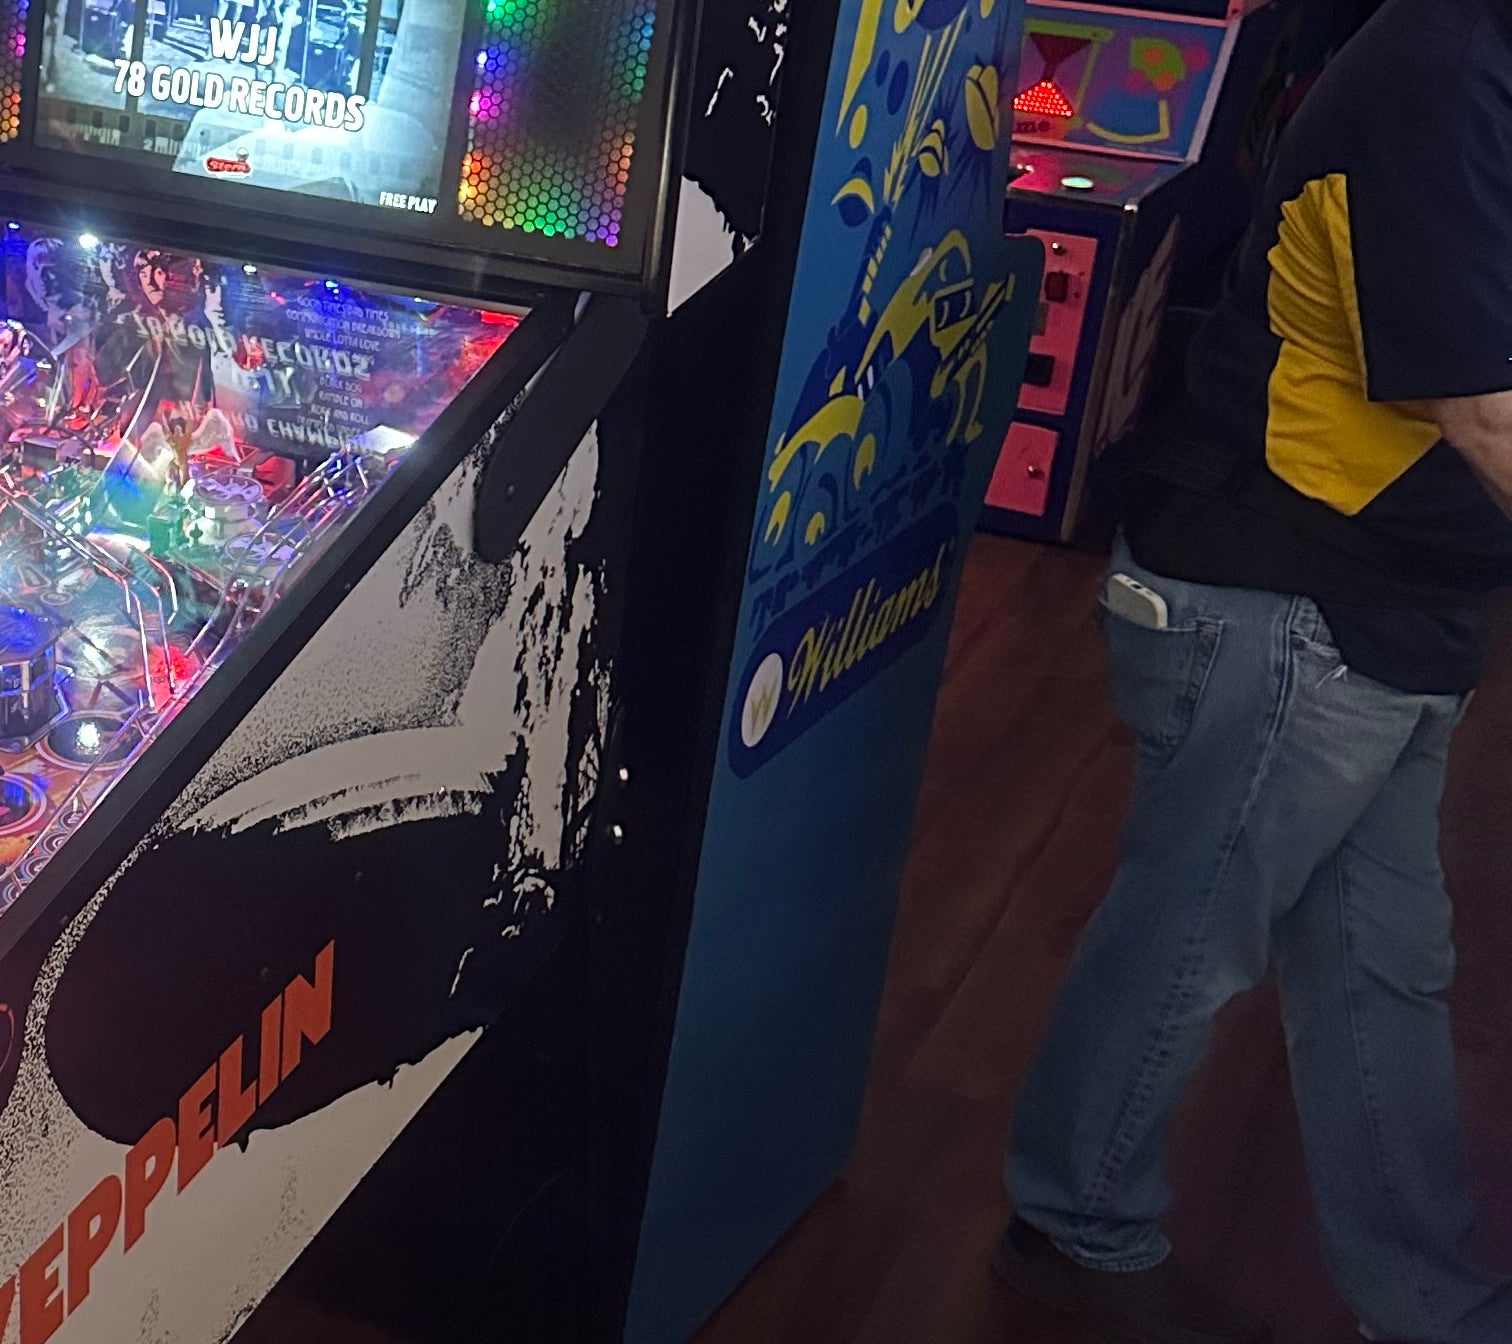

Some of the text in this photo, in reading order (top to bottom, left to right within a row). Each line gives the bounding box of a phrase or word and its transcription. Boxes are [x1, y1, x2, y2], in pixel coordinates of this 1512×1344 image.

[210, 18, 278, 66] WJJ
[114, 58, 367, 132] 78 GOLD RECORDS
[379, 191, 437, 214] FREE PLAY
[787, 542, 946, 719] Williams
